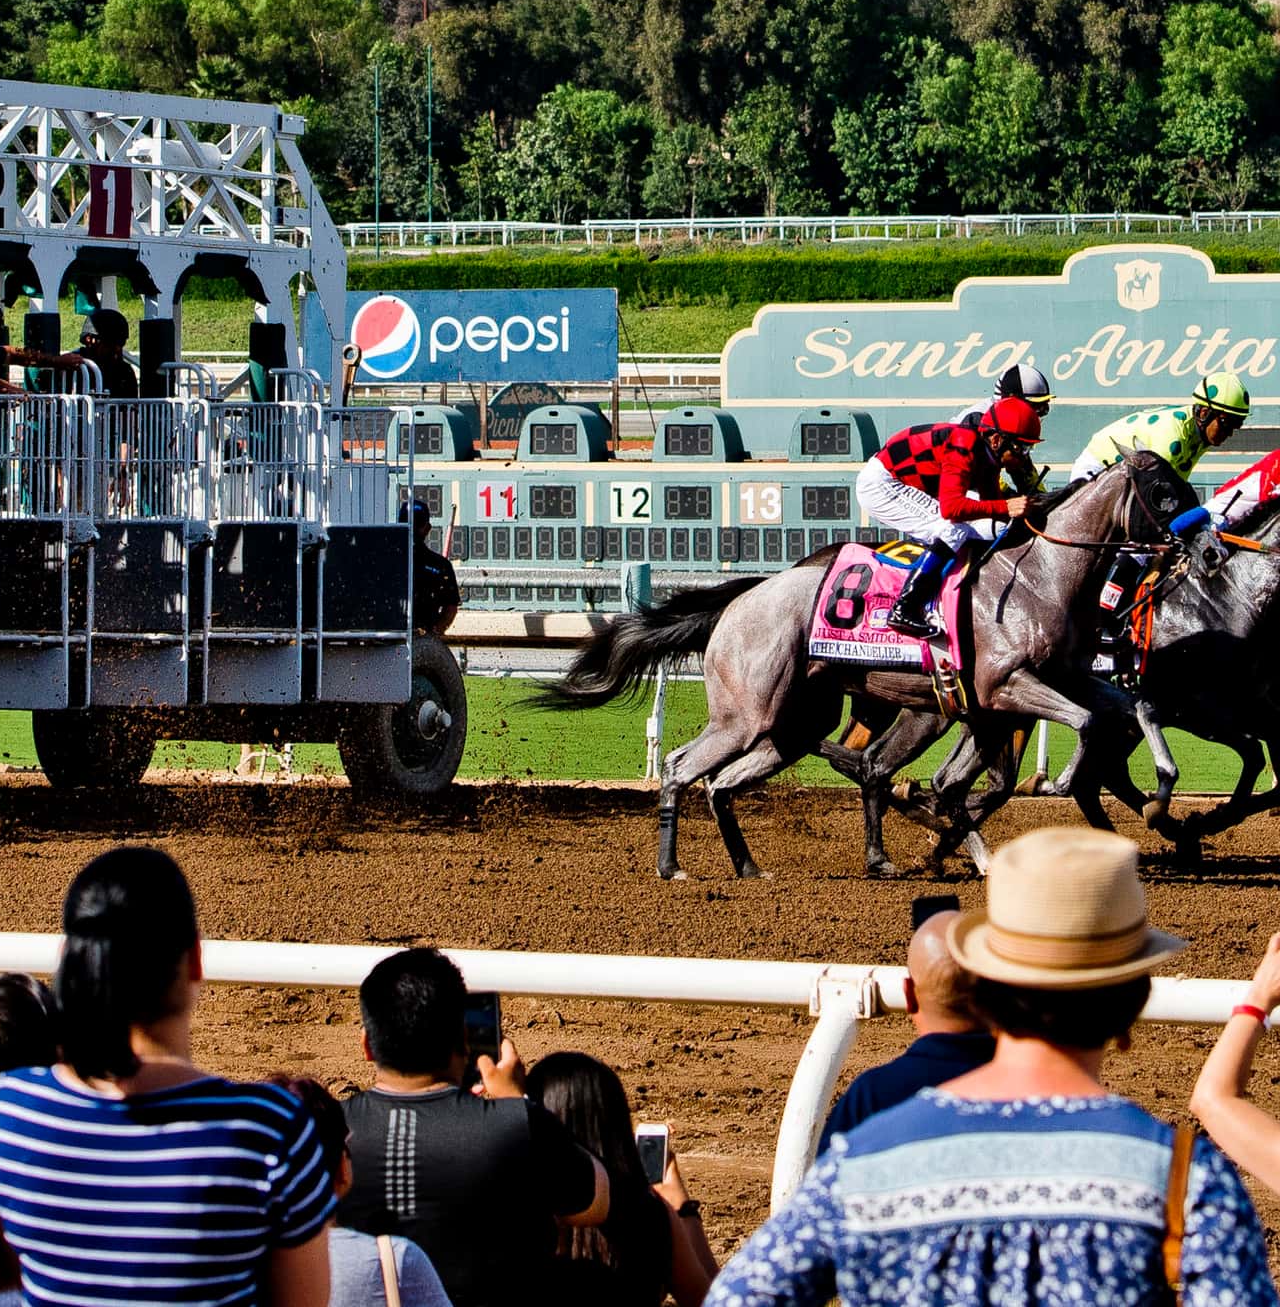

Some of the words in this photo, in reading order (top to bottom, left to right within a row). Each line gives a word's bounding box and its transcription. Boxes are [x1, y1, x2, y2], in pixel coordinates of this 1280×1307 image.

[102, 169, 115, 235] 1
[429, 306, 569, 363] pepsi
[795, 327, 1035, 378] Santa
[1053, 324, 1278, 387] Anita
[487, 407, 521, 437] Picni
[479, 485, 514, 518] 11
[613, 486, 650, 518] 12
[740, 486, 782, 521] 13
[824, 563, 873, 629] 8
[814, 642, 835, 654] THE
[836, 643, 902, 659] CHANDELIER
[815, 627, 846, 639] JUST
[859, 632, 904, 644] SMIDGE
